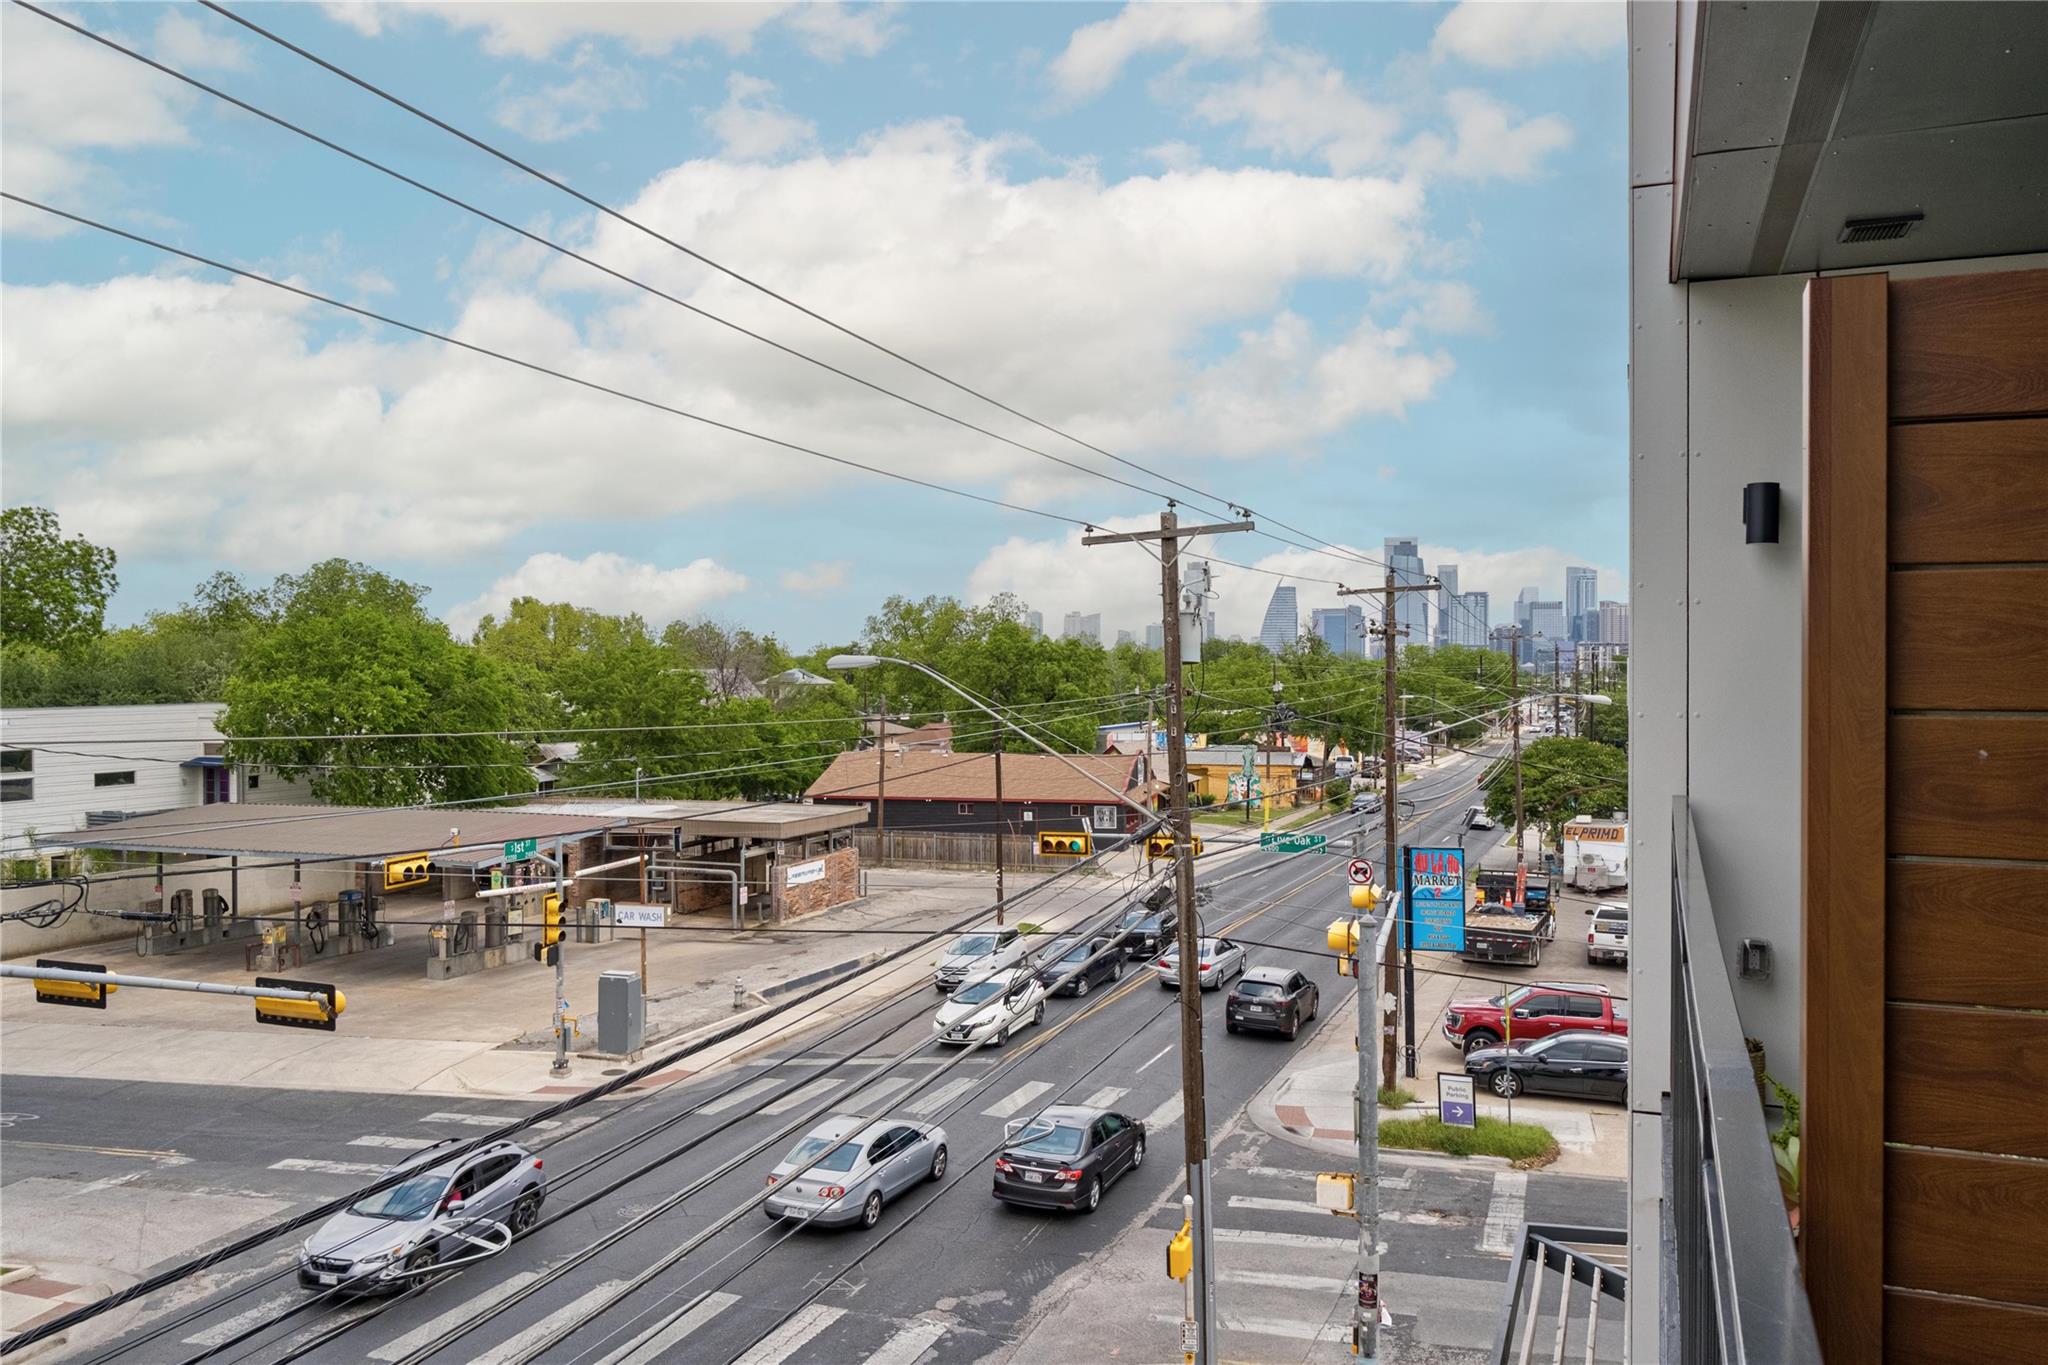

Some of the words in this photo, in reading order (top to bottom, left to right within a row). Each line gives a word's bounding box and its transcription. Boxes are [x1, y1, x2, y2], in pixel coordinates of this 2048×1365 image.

[1566, 827, 1579, 835] EL
[1579, 827, 1619, 840] PRIMO
[1294, 836, 1311, 846] Oak
[1414, 874, 1462, 886] MARKET
[1434, 887, 1441, 897] 2
[618, 911, 635, 921] CAR
[638, 911, 663, 922] WASH
[1447, 1085, 1467, 1093] Public
[1446, 1091, 1469, 1099] Parking
